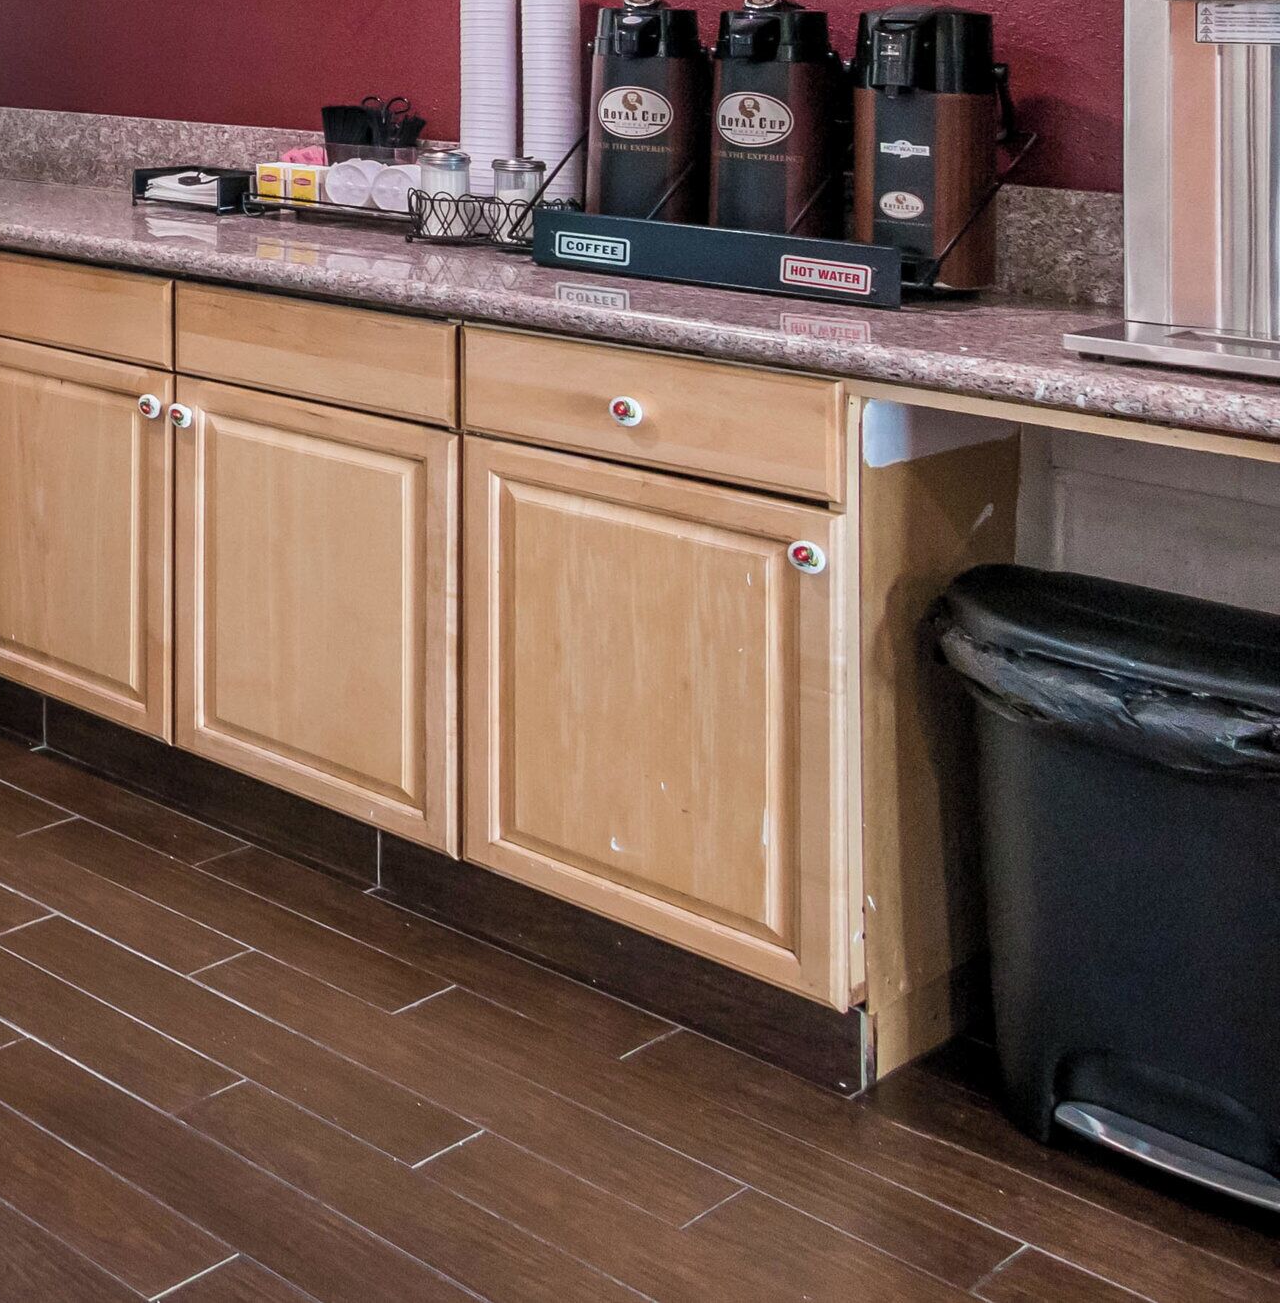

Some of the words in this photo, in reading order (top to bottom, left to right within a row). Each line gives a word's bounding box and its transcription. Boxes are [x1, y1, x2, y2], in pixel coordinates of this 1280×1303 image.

[603, 108, 637, 120] ROYAL
[642, 111, 666, 123] CUP
[721, 115, 755, 129] ROYAL
[759, 117, 785, 129] CUP
[899, 146, 927, 154] WATER
[567, 240, 619, 256] COFFEE
[790, 265, 813, 279] HOT
[819, 269, 860, 285] WATER
